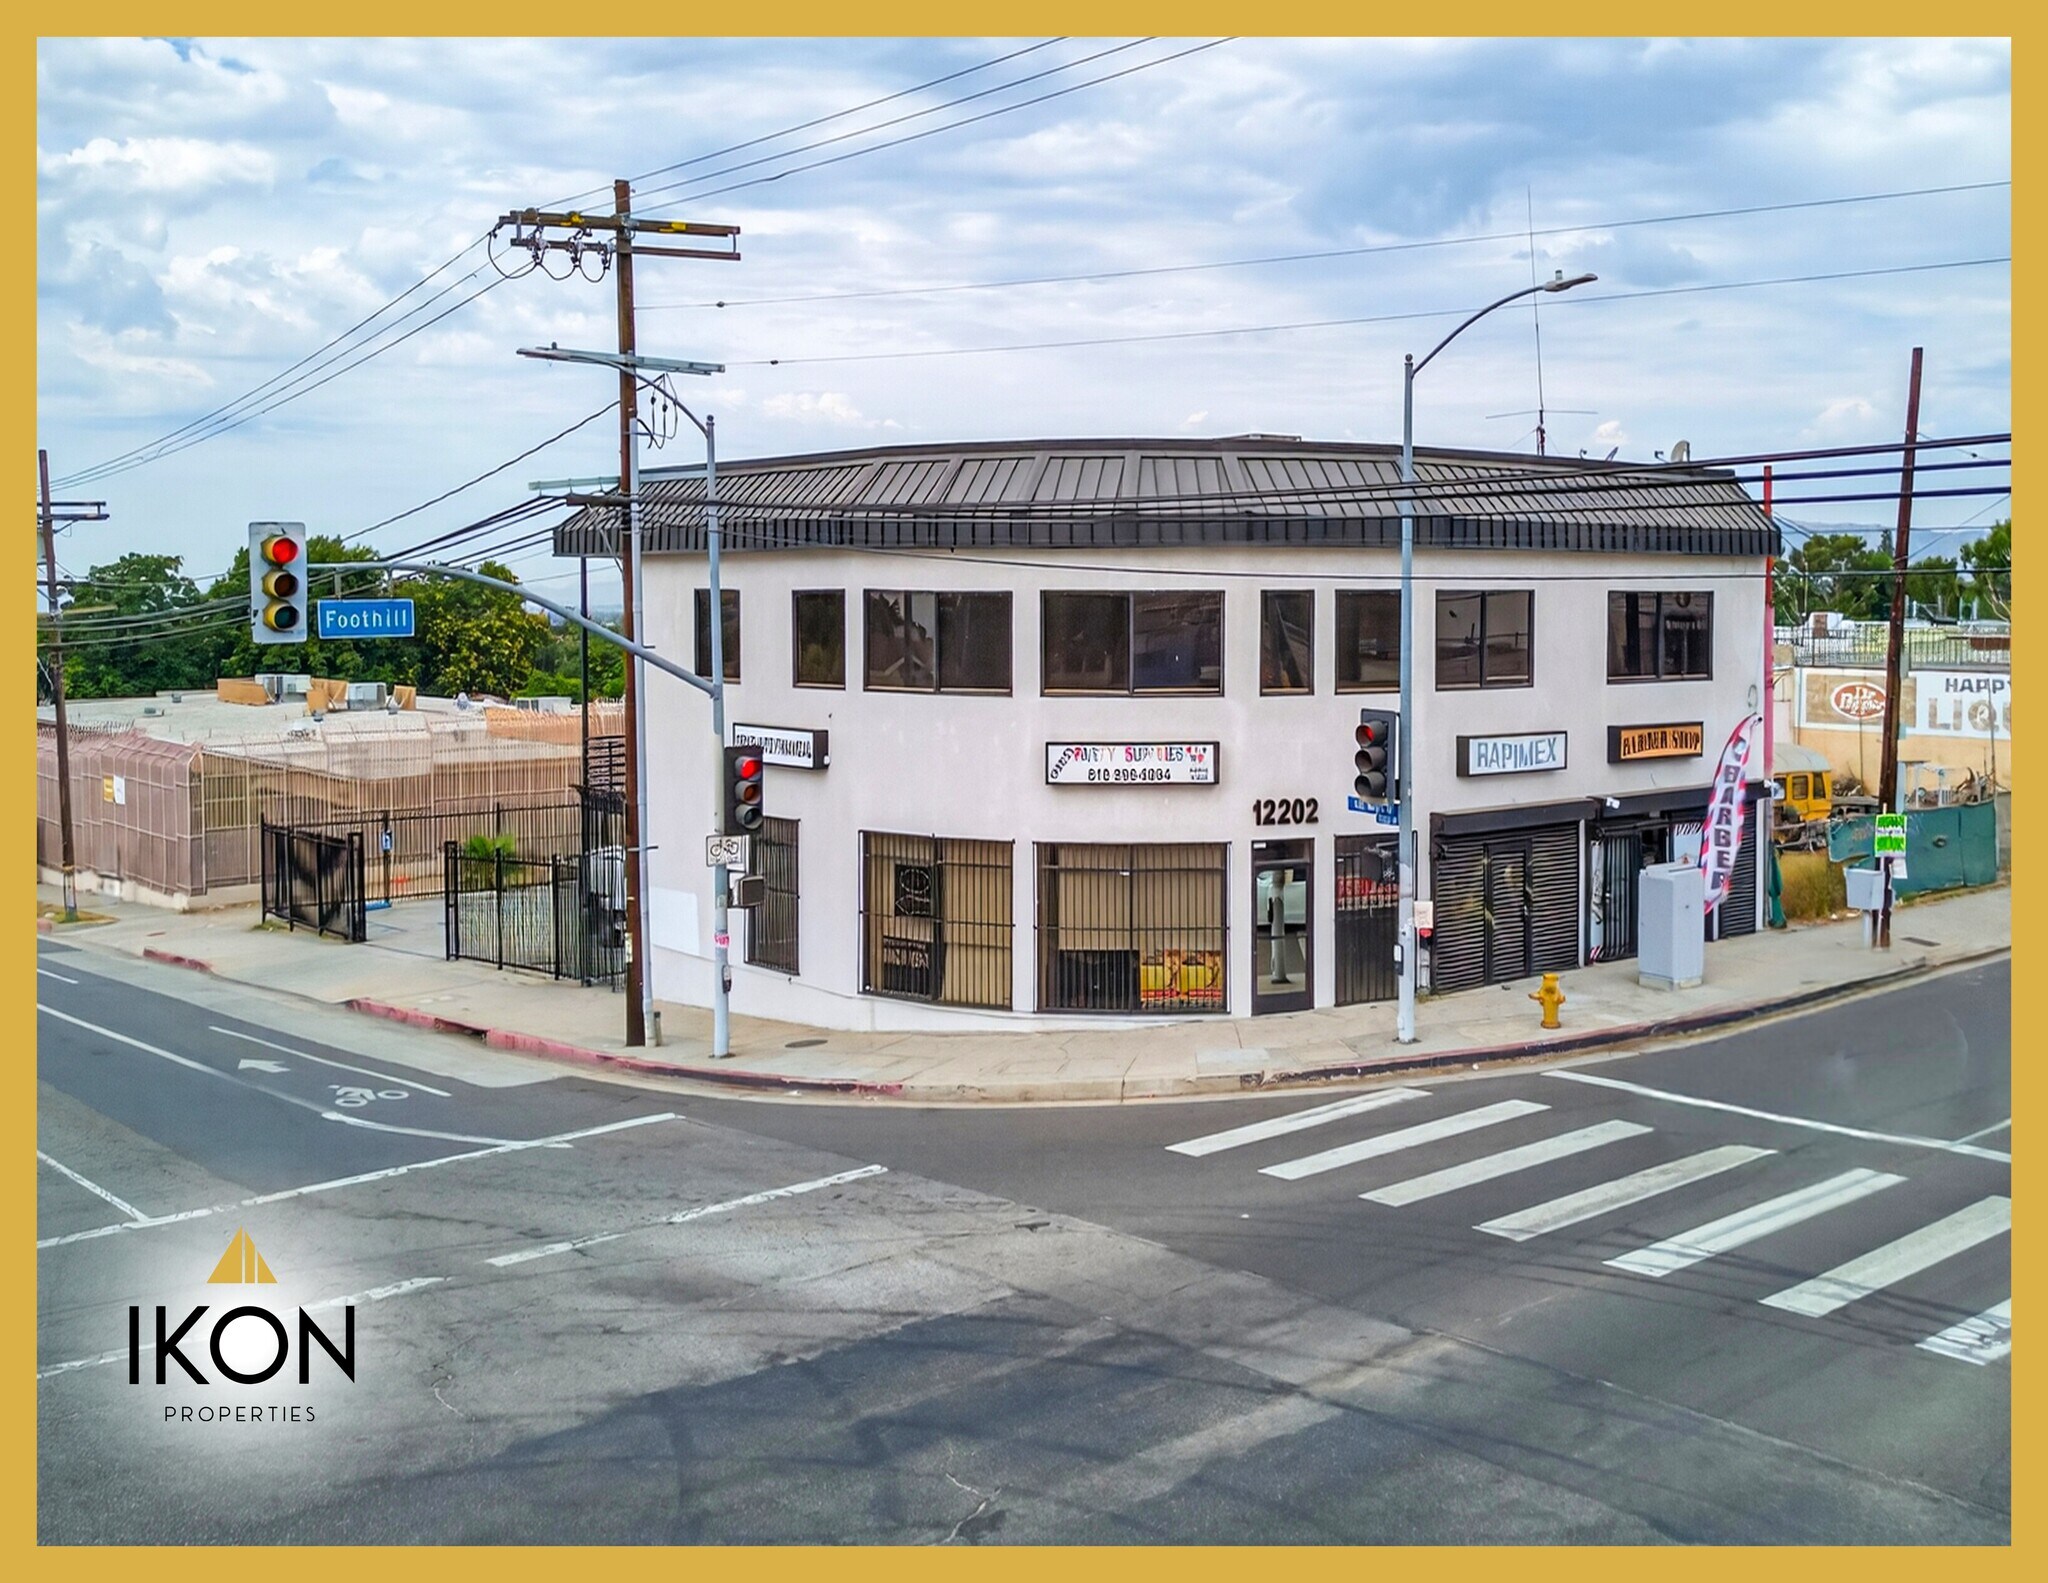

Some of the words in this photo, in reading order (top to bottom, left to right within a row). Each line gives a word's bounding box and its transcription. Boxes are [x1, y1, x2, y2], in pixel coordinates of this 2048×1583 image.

[325, 608, 407, 629] Foothill
[1945, 678, 2010, 694] HAPP
[1477, 737, 1557, 769] RAPIMEX
[1252, 797, 1319, 826] 12202
[1710, 764, 1742, 891] BARBER
